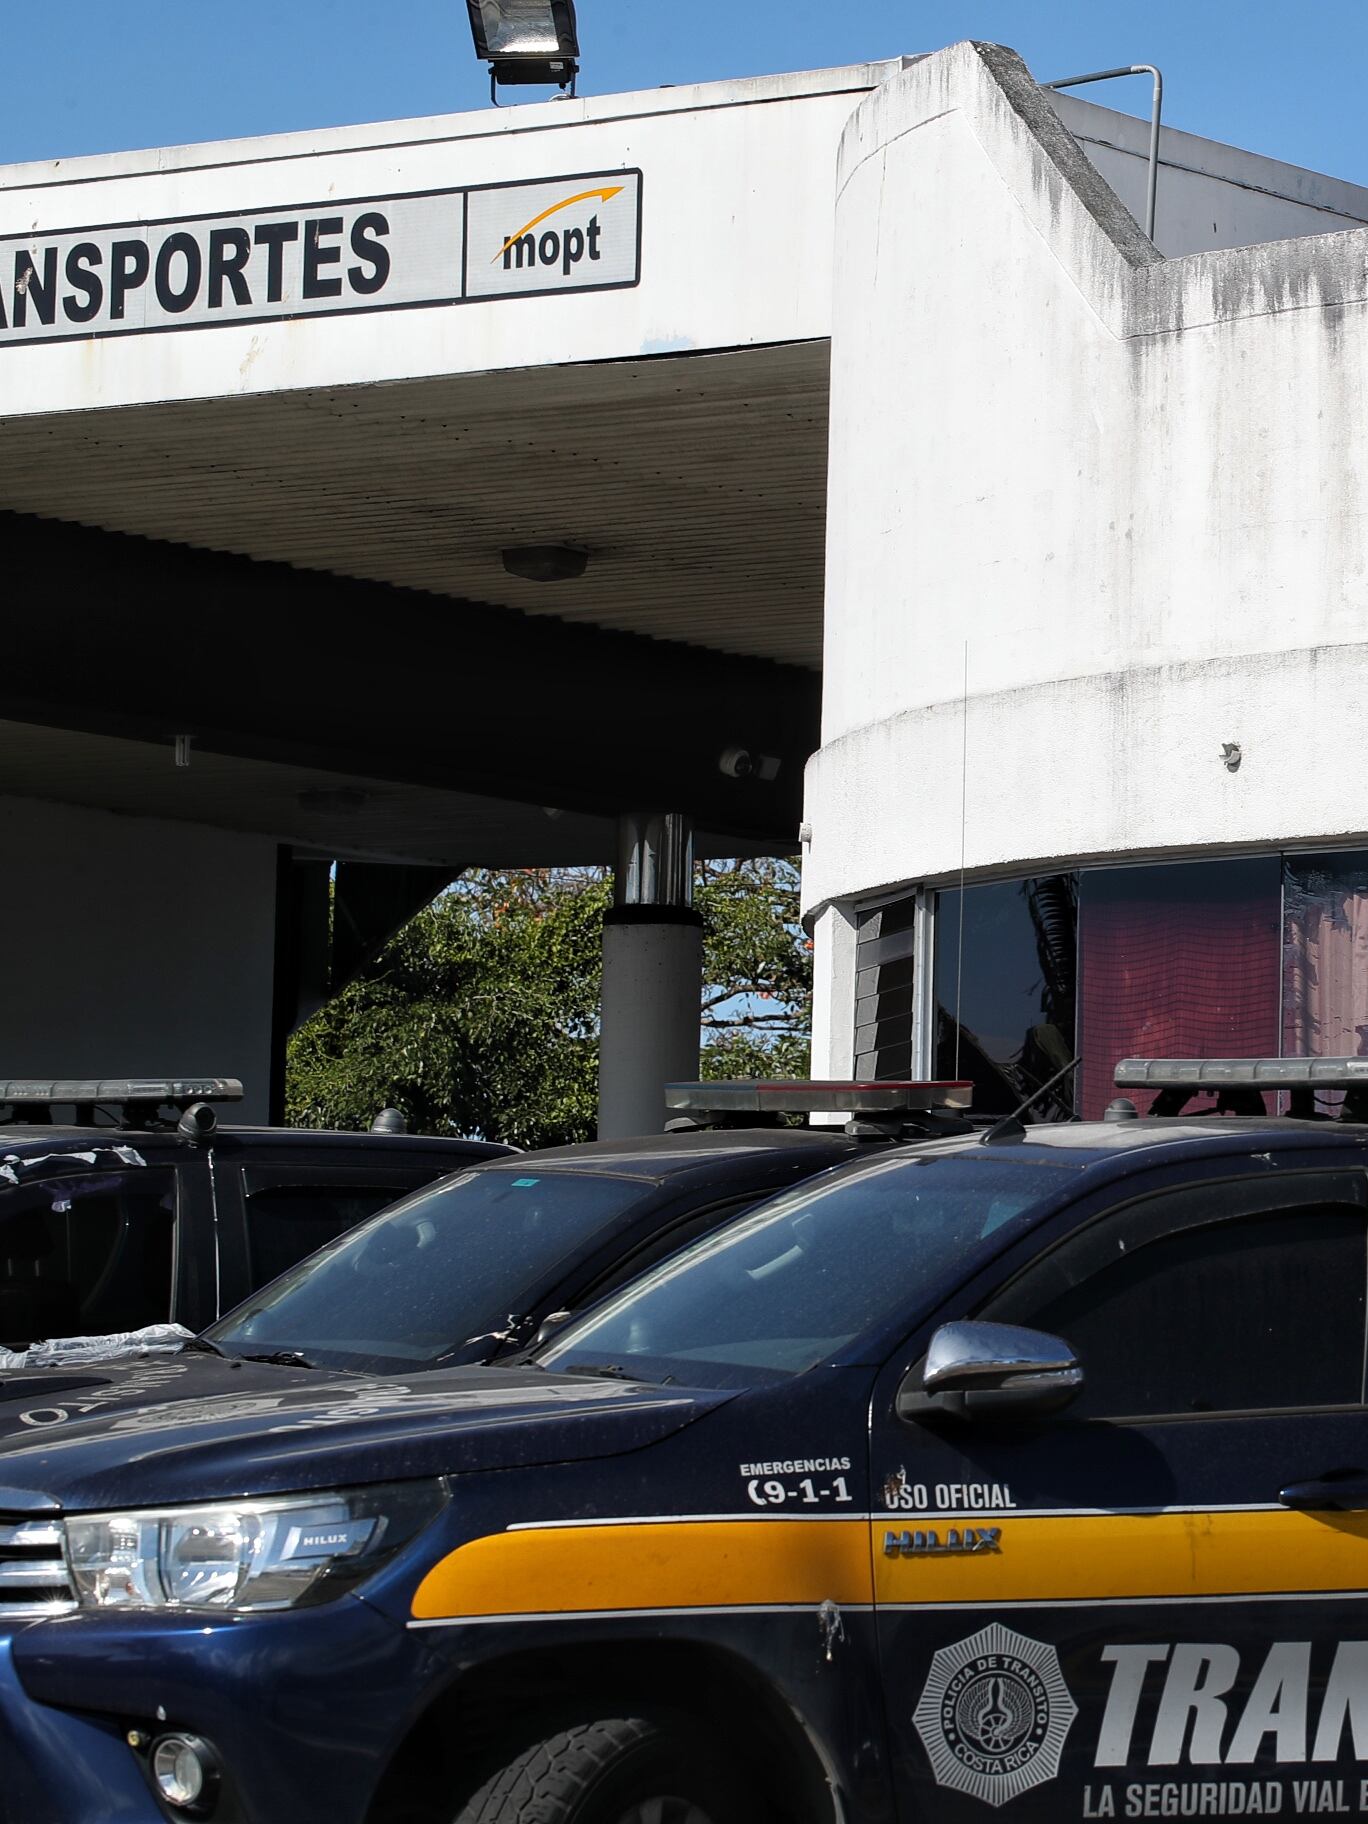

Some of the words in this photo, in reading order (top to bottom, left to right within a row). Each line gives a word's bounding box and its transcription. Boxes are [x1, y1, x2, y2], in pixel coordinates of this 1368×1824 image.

[502, 214, 601, 276] mopt
[0, 212, 390, 329] NSPORTES
[740, 1457, 851, 1477] EMERGENCIAS
[884, 1483, 928, 1509] USO
[935, 1483, 1017, 1509] OFICIAL
[303, 1534, 348, 1546] HILUX
[884, 1527, 1003, 1554] HILUX
[943, 1667, 975, 1730] POLICIA
[976, 1656, 998, 1671] DE
[1002, 1657, 1048, 1725] TRANSITO
[954, 1743, 1003, 1774] COSTA
[1004, 1741, 1039, 1771] RICA
[1083, 1784, 1115, 1818] LA
[1125, 1781, 1283, 1817] SEGURIDAD
[1292, 1780, 1350, 1813] VIAL
